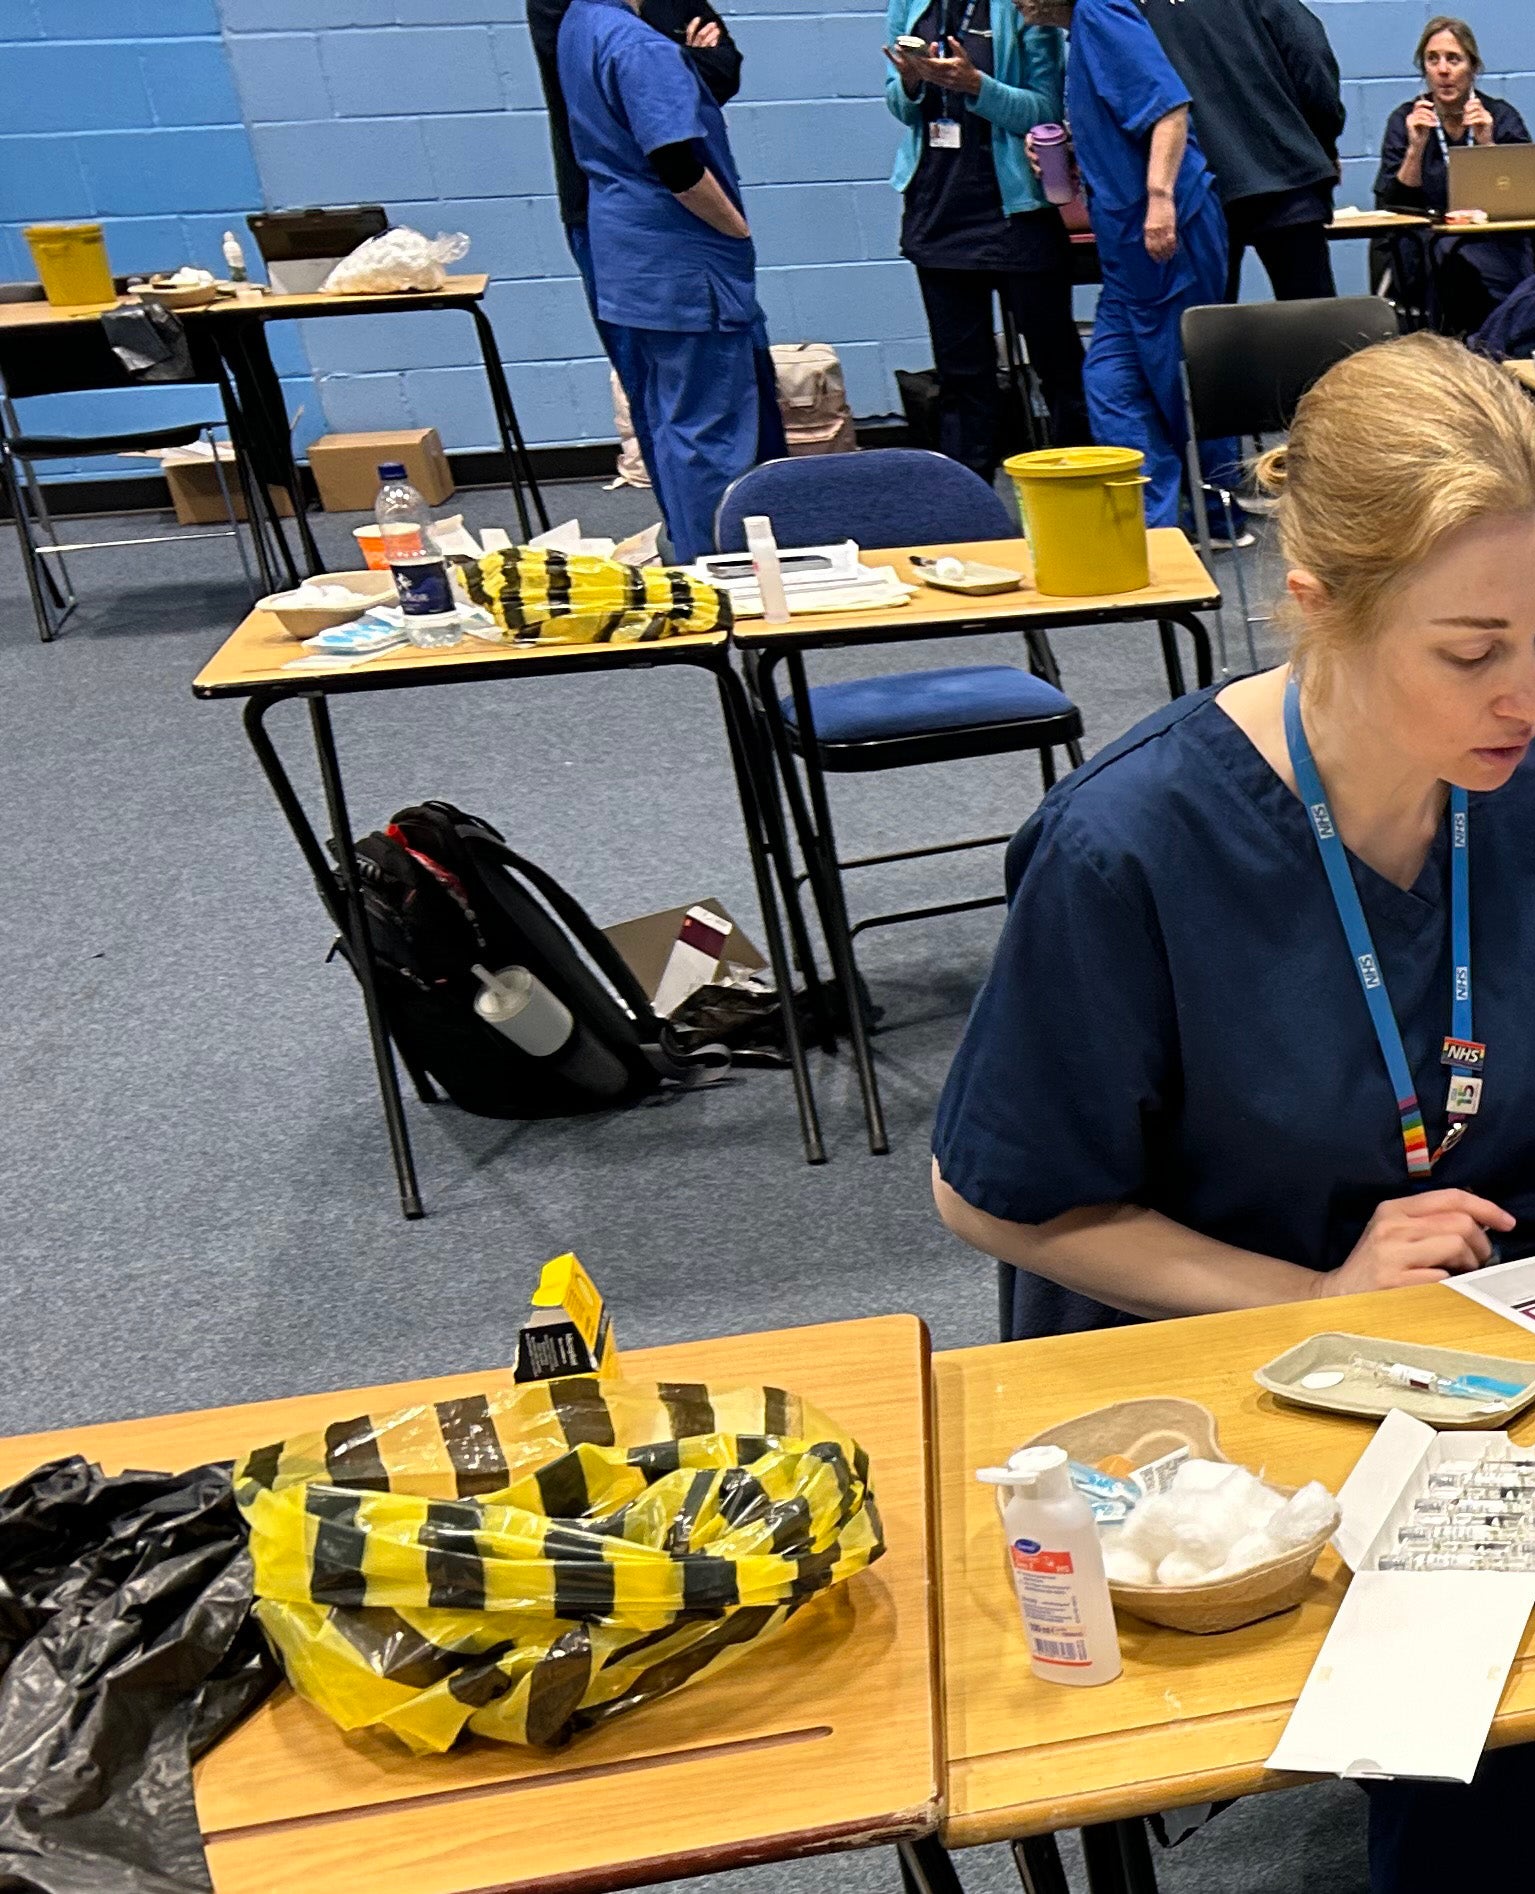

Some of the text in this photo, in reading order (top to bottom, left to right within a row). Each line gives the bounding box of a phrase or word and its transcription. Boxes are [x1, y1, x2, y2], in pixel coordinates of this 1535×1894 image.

[1313, 806, 1333, 836] NHS
[1455, 814, 1465, 846] NHS
[1360, 956, 1378, 986] NHS
[1457, 969, 1467, 999] NHS
[1447, 1045, 1480, 1063] NHS
